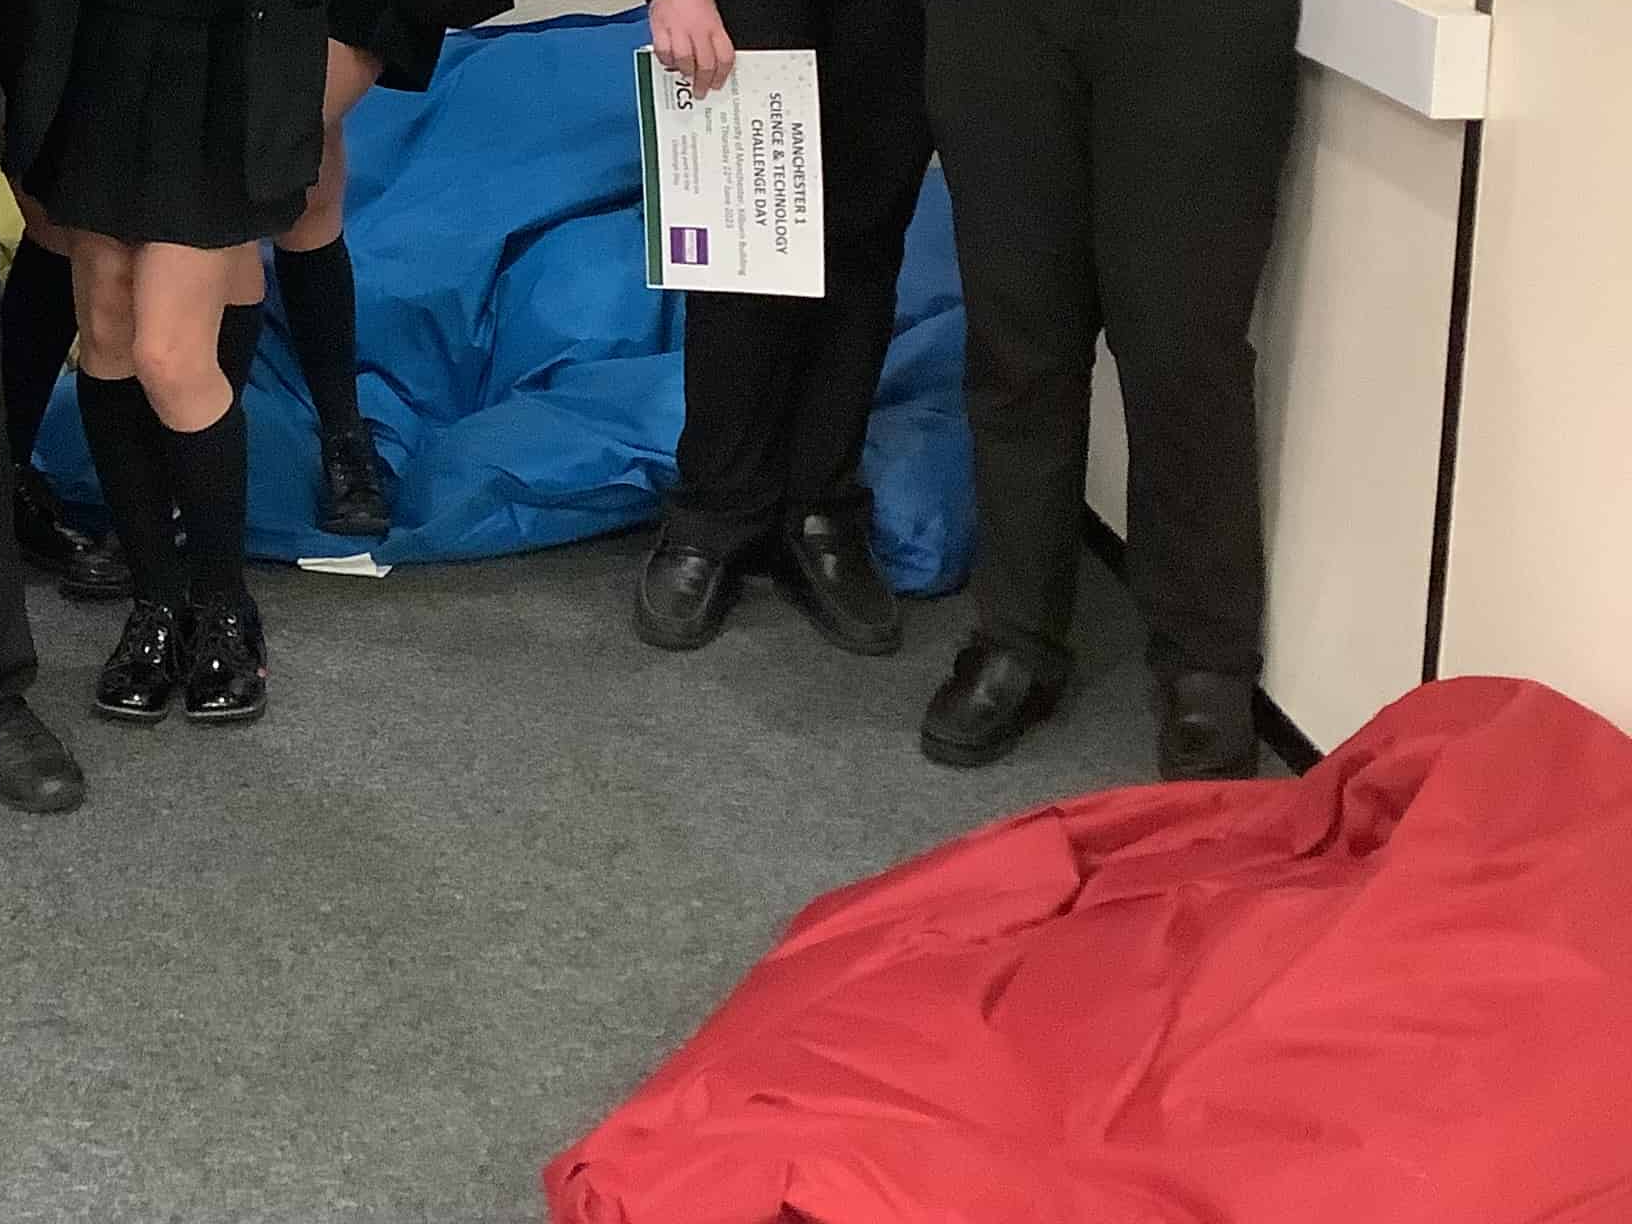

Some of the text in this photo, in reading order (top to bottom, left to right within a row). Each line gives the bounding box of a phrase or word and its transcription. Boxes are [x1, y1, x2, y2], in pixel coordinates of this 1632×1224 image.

[751, 119, 768, 227] CHALLENGE DAY
[769, 92, 789, 255] SCIENCE & TECHNOLOGY
[791, 122, 808, 214] MANCHESTER
